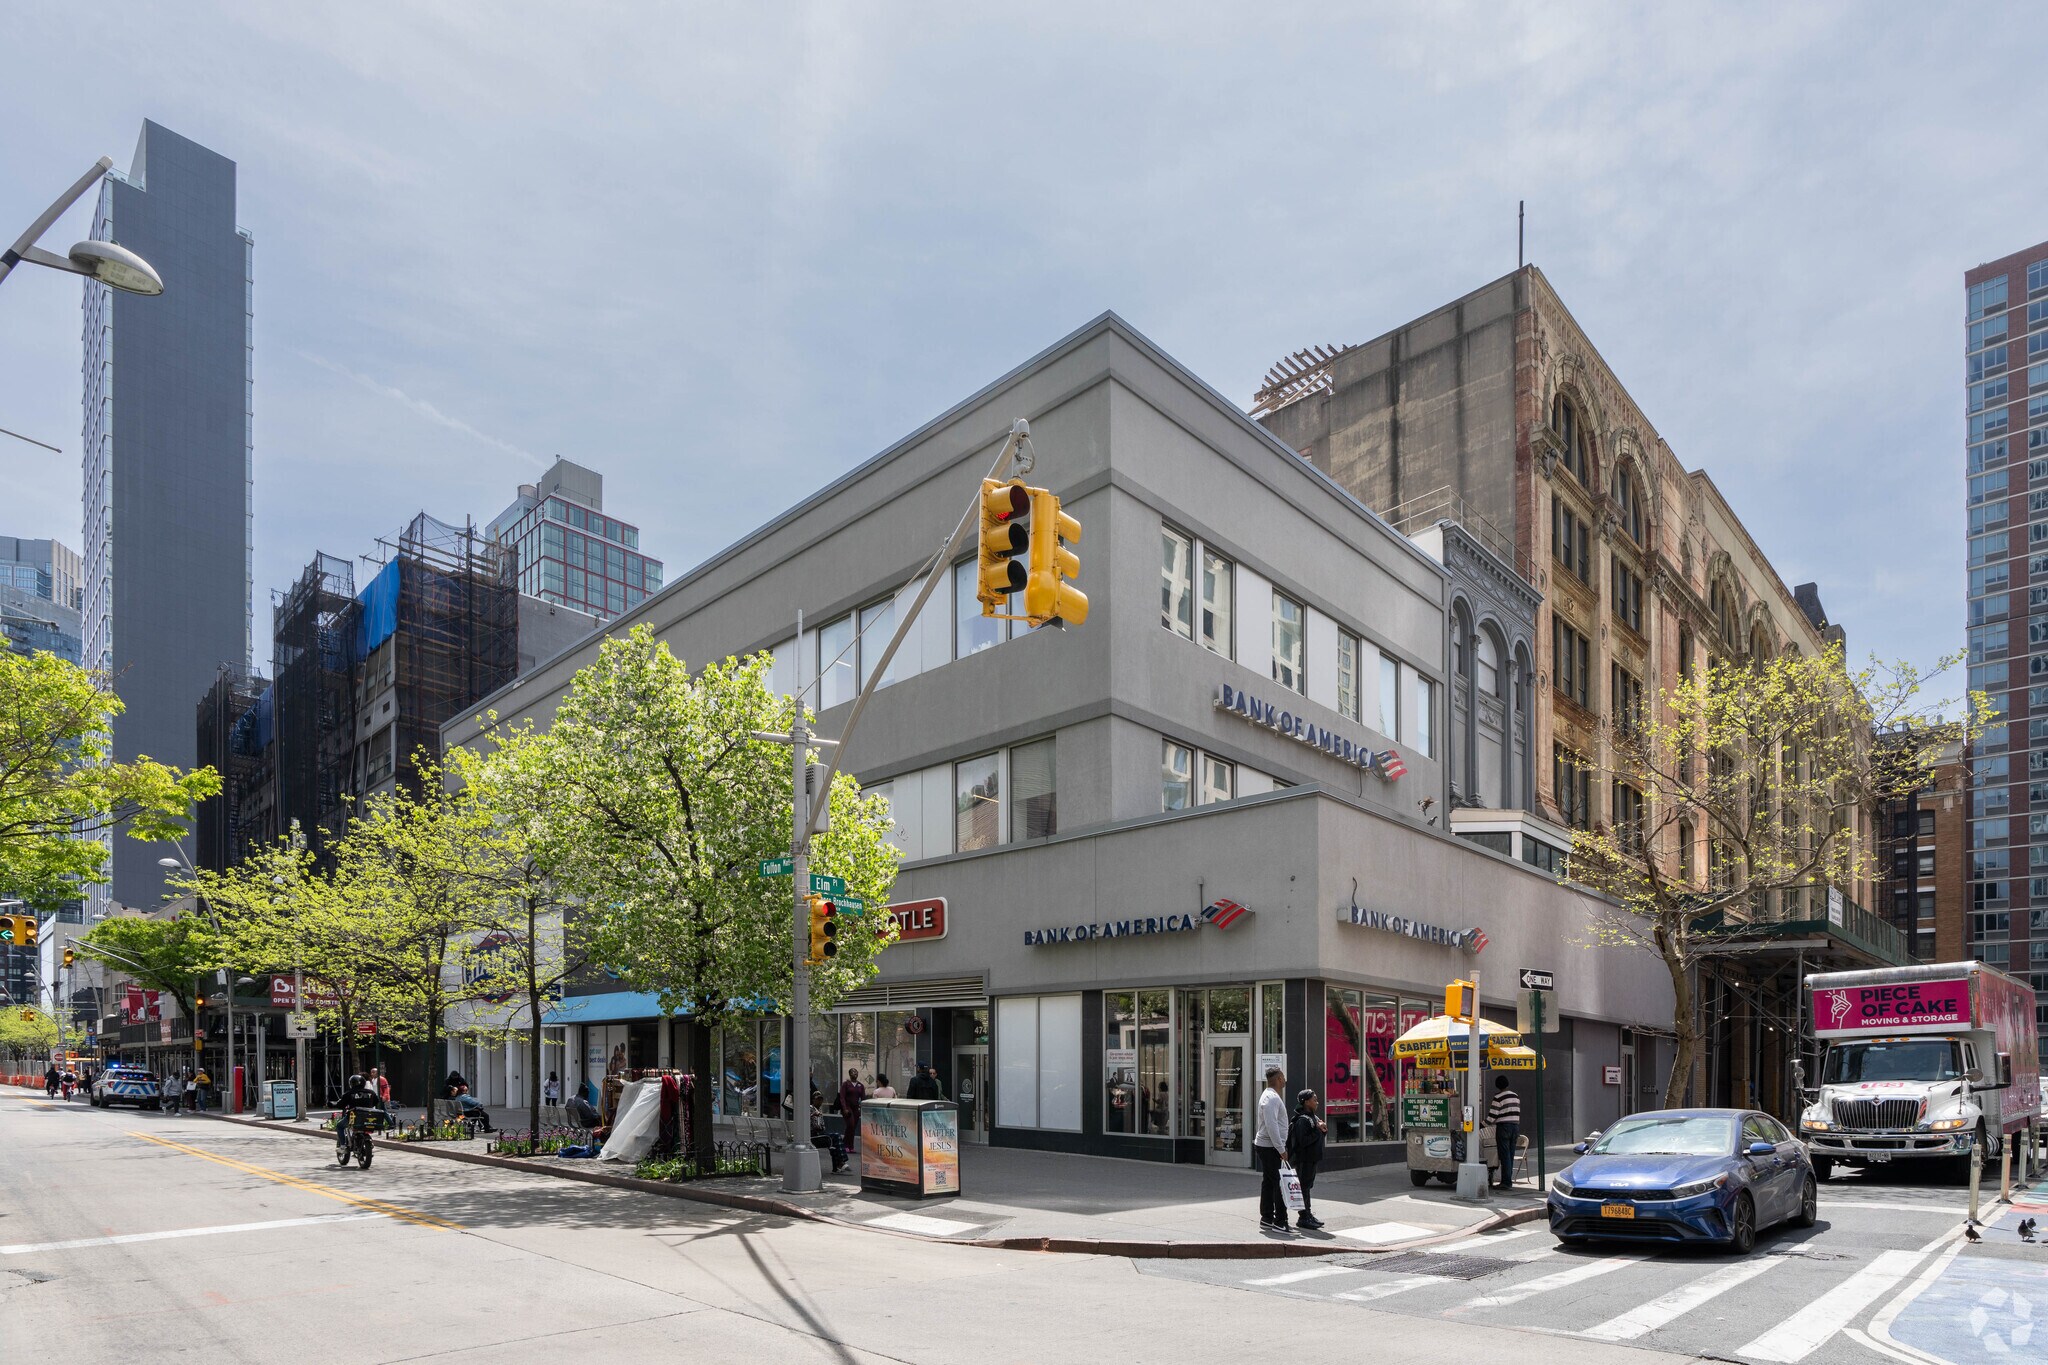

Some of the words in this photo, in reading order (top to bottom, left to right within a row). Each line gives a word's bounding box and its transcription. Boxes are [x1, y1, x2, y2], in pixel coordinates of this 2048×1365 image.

[1222, 683, 1276, 727] BANK
[1278, 711, 1302, 737] OF
[1304, 723, 1377, 769] AMERICA
[763, 861, 781, 875] Fulton
[816, 877, 830, 892] Elm
[1024, 926, 1072, 946] BANK
[1075, 924, 1098, 940] OF
[1102, 914, 1194, 938] AMERICA
[1351, 905, 1389, 931] BANK
[1392, 916, 1409, 934] OF
[1412, 921, 1464, 948] AMERICA
[1526, 976, 1536, 984] ONE
[1540, 977, 1550, 985] WAY
[1860, 986, 1920, 1002] PIECE
[1861, 1002, 1892, 1017] OF
[1895, 998, 1957, 1015] CAKE
[1222, 1020, 1238, 1031] 474
[1861, 1017, 1900, 1026] MOVING
[1911, 1014, 1958, 1022] STORAGE
[974, 1026, 988, 1034] 474
[1399, 1040, 1445, 1052] SABRETT
[1492, 1036, 1520, 1045] SABRETT
[1418, 1056, 1446, 1066] SABRETT
[1492, 1058, 1534, 1066] SABRETT
[870, 1123, 907, 1138] MATTER
[924, 1129, 955, 1138] MATTER
[876, 1144, 903, 1158] JESUS
[929, 1142, 952, 1150] JESUS
